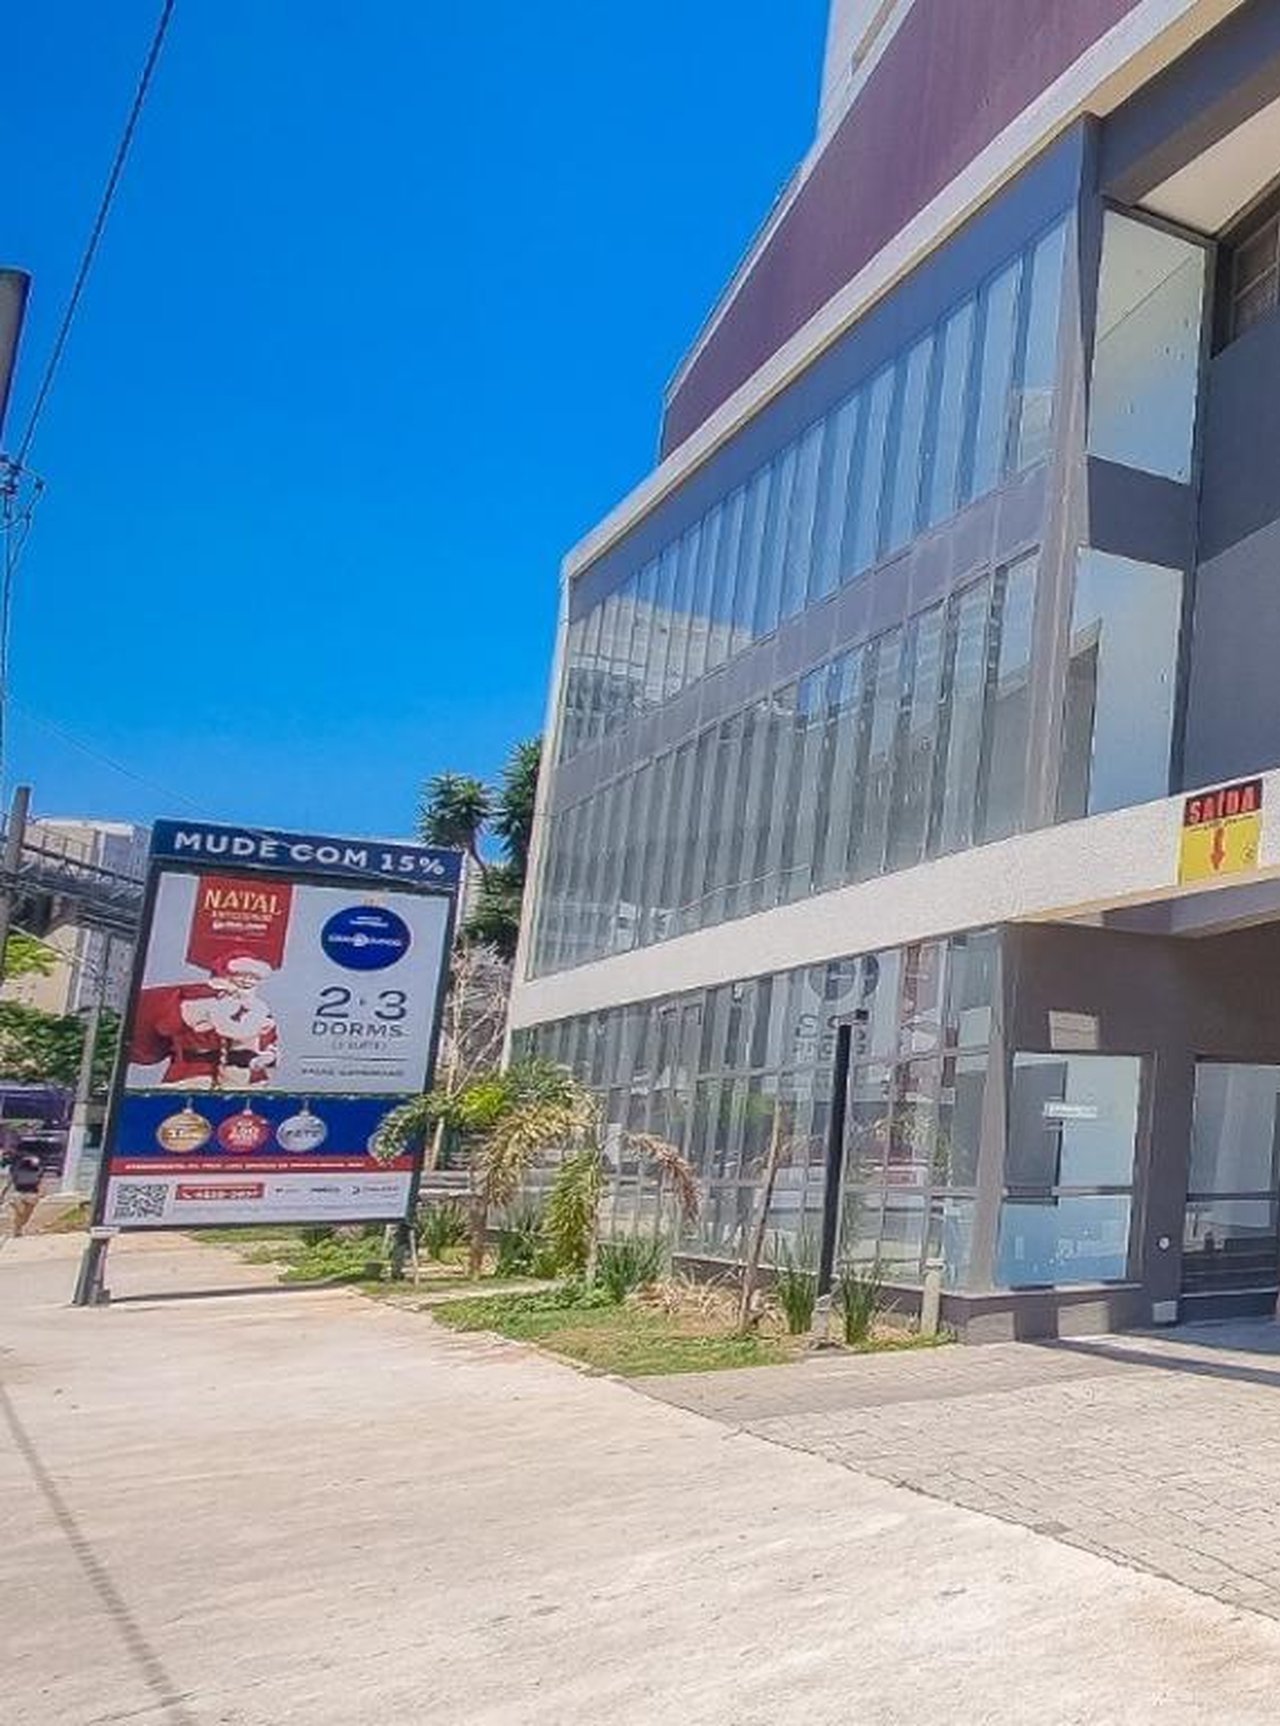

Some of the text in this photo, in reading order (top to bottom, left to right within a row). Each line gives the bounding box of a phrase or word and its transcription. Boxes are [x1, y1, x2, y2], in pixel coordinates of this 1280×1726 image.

[174, 831, 446, 876] MUDE COM 15%
[203, 889, 282, 915] NATAL
[315, 986, 408, 1020] 2 3
